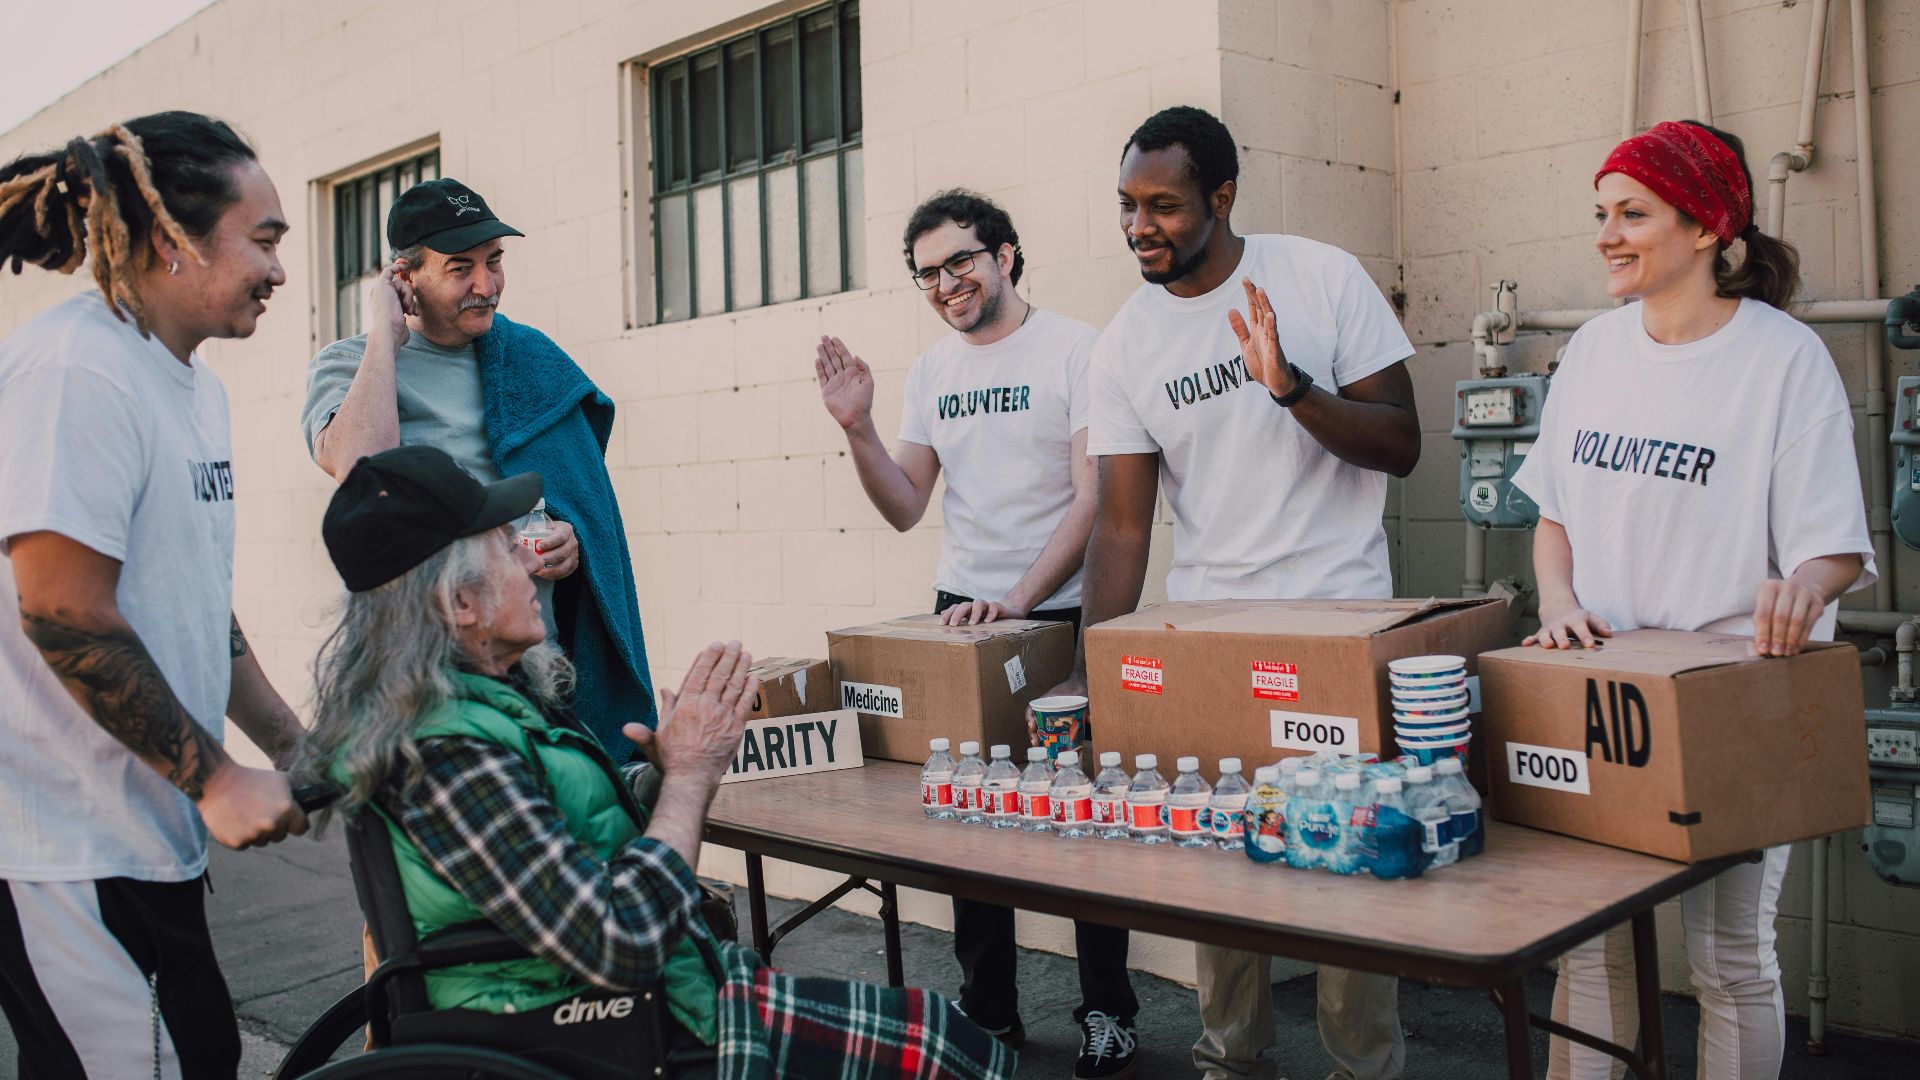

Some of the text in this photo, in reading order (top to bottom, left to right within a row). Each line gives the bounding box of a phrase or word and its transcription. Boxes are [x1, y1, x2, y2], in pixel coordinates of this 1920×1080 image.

[939, 385, 1030, 420] VOLUNTEER
[1572, 429, 1716, 486] VOLUNTEER
[1125, 668, 1159, 682] FRAGILE
[1256, 675, 1294, 688] FRAGILE
[844, 685, 899, 714] Medicine
[1284, 720, 1345, 746] FOOD
[1586, 677, 1652, 768] AID
[1516, 750, 1578, 783] FOOD
[553, 996, 635, 1026] drive
